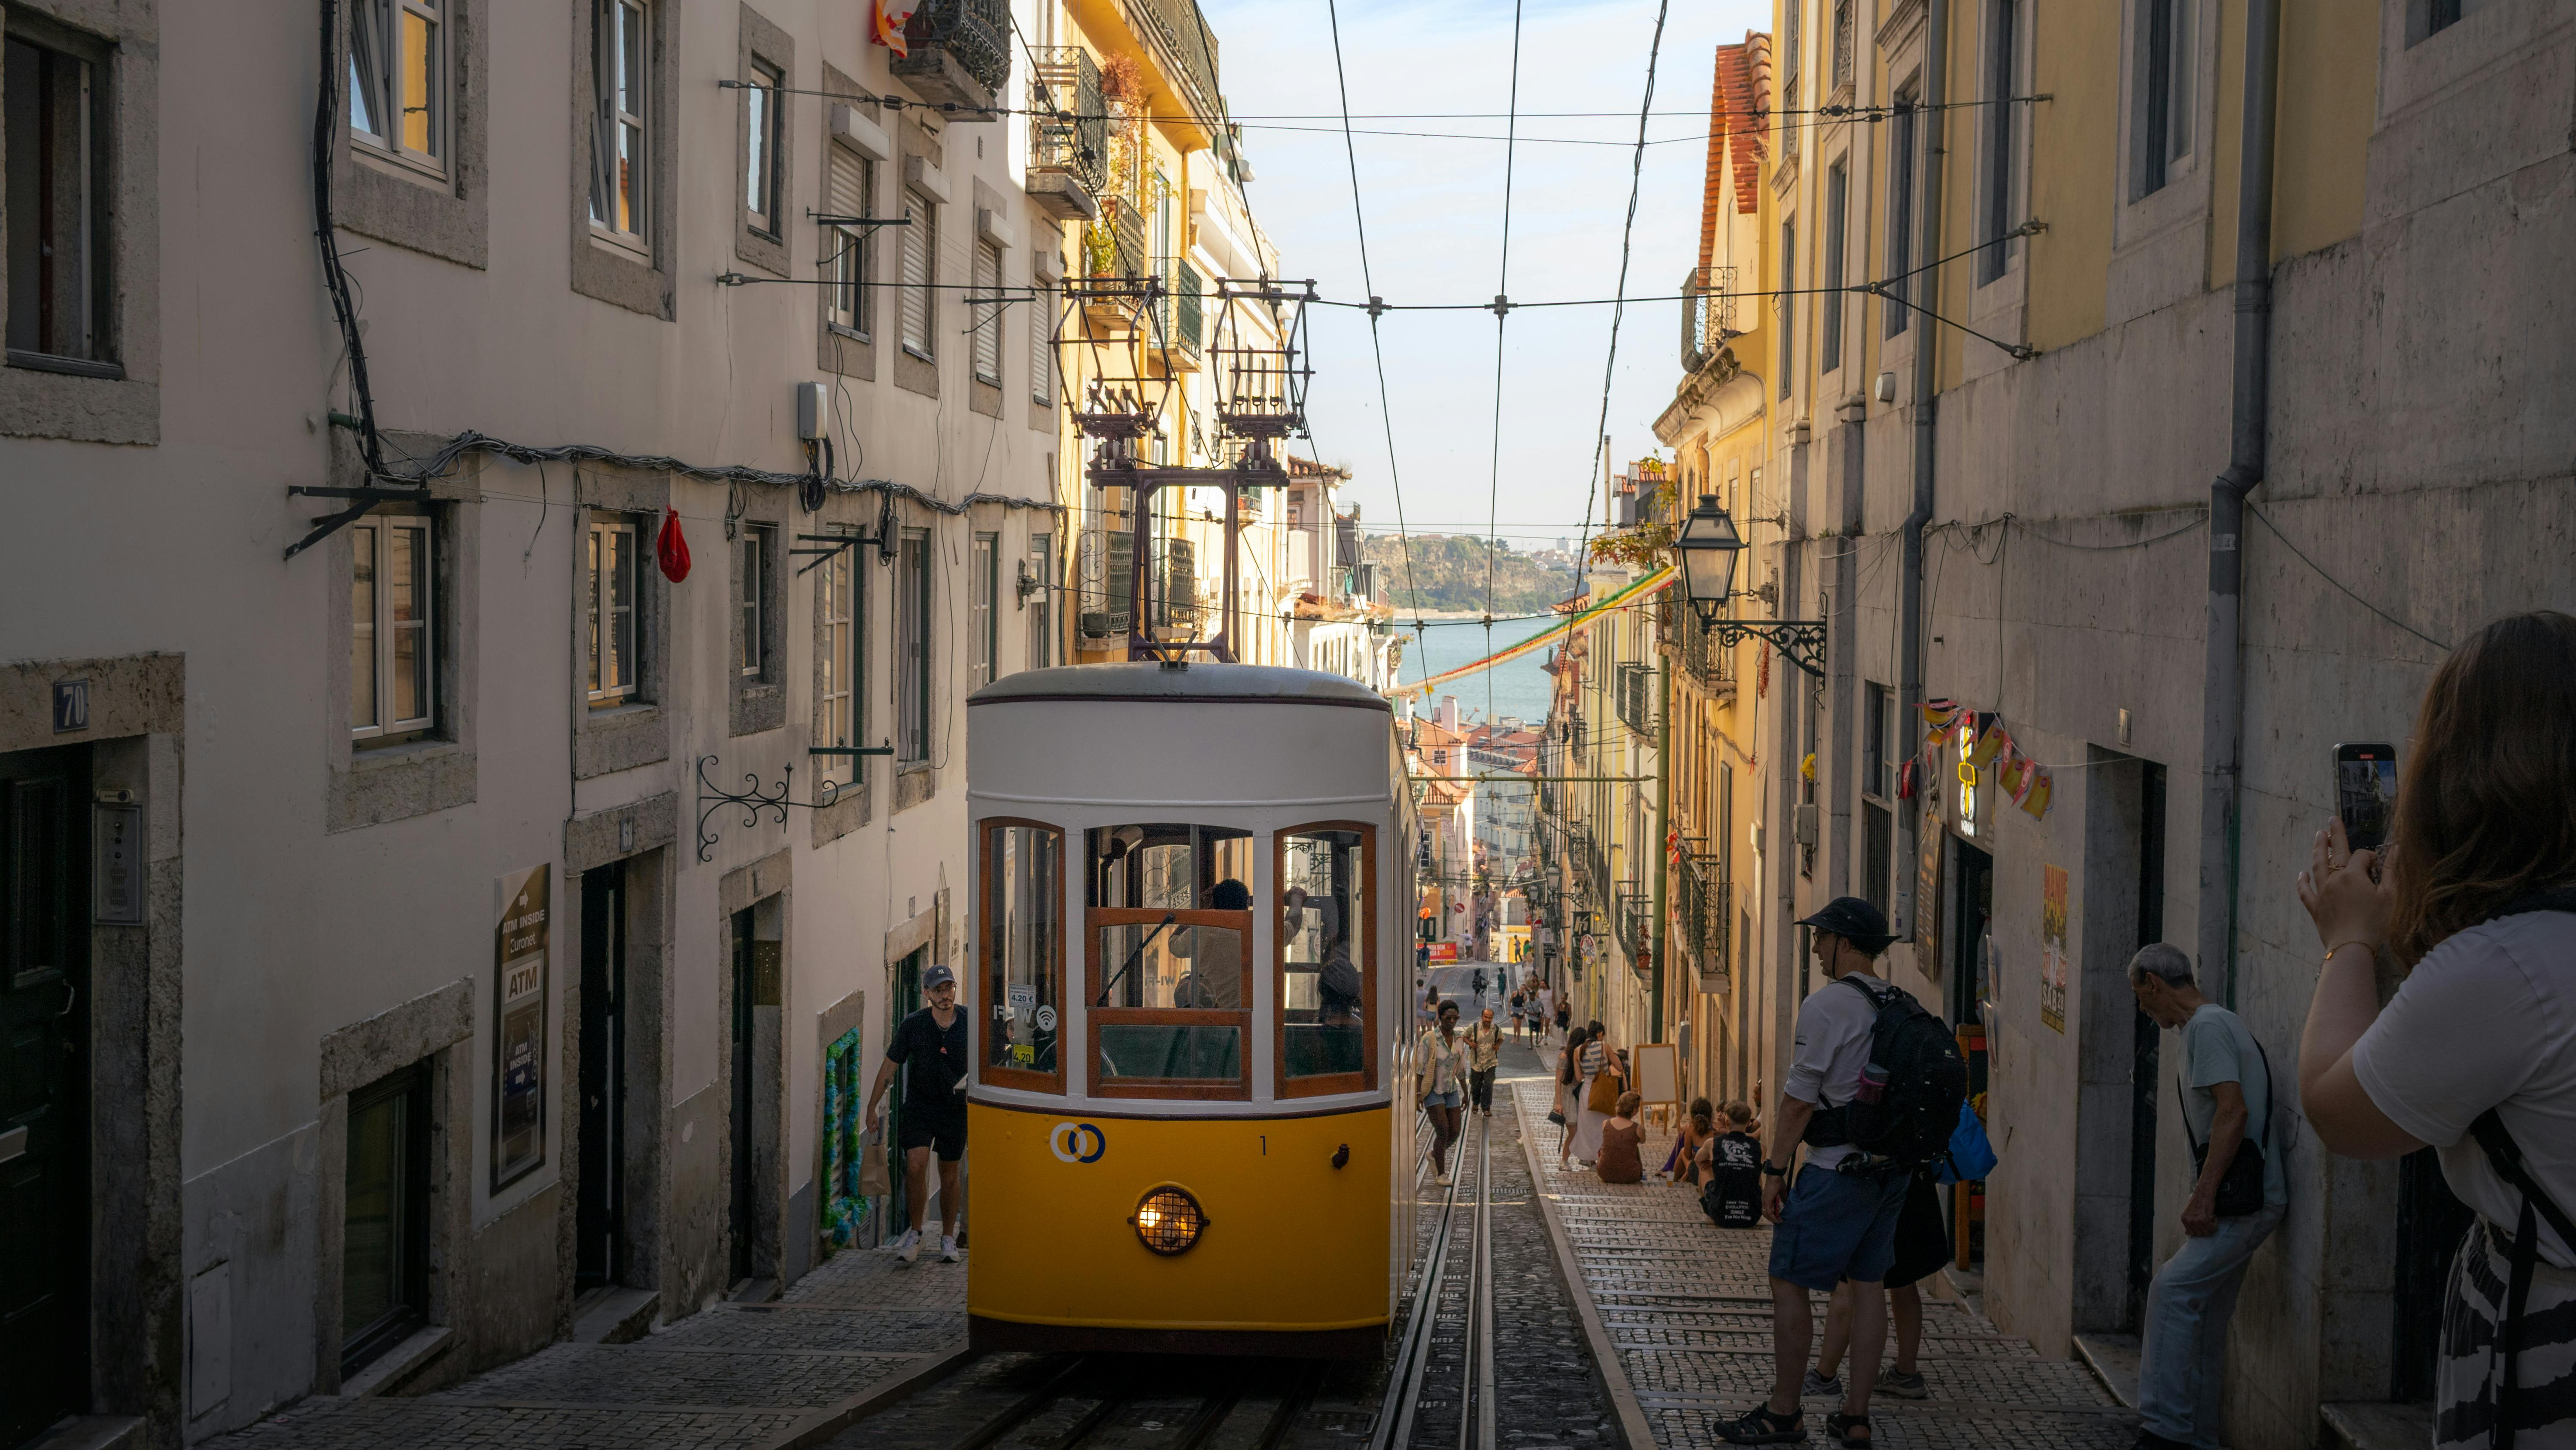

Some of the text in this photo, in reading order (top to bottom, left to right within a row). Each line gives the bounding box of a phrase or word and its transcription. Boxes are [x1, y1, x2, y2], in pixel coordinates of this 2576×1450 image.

[62, 685, 85, 726] 70
[623, 822, 632, 846] 68
[502, 909, 545, 935] ATM INSIDE
[510, 931, 536, 954] Euronet
[508, 965, 538, 998] ATM
[1011, 994, 1027, 1002] 4.20
[2057, 992, 2064, 1011] 28
[515, 1041, 528, 1056] ATM
[510, 1052, 532, 1071] INSIDE
[1259, 1135, 1266, 1156] 1
